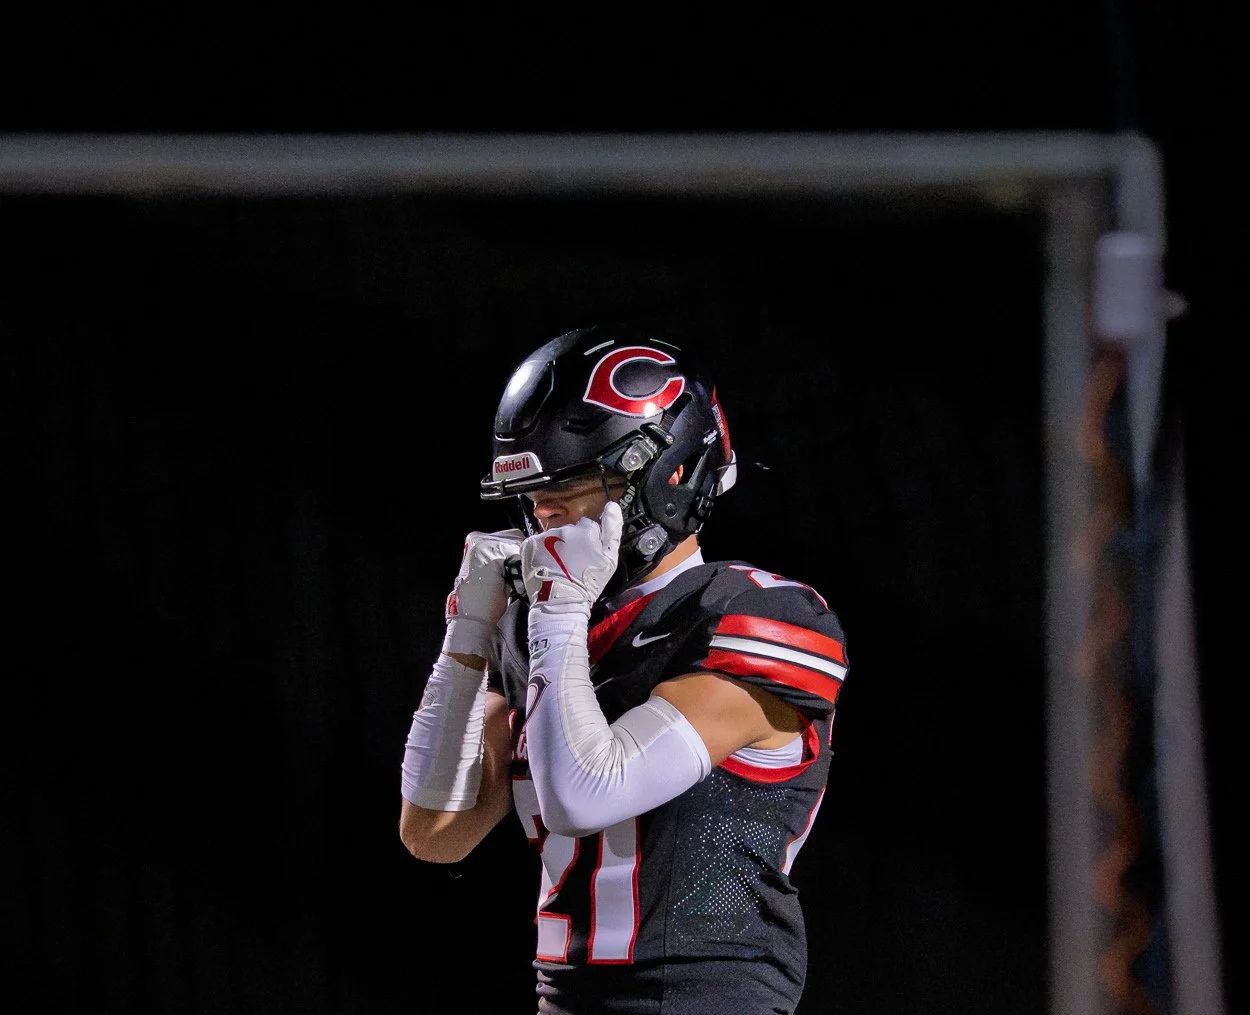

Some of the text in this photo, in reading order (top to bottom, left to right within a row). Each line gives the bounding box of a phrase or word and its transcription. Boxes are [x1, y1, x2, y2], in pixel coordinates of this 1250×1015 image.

[583, 346, 685, 418] C
[495, 456, 530, 473] Riddell
[512, 776, 642, 965] 21
